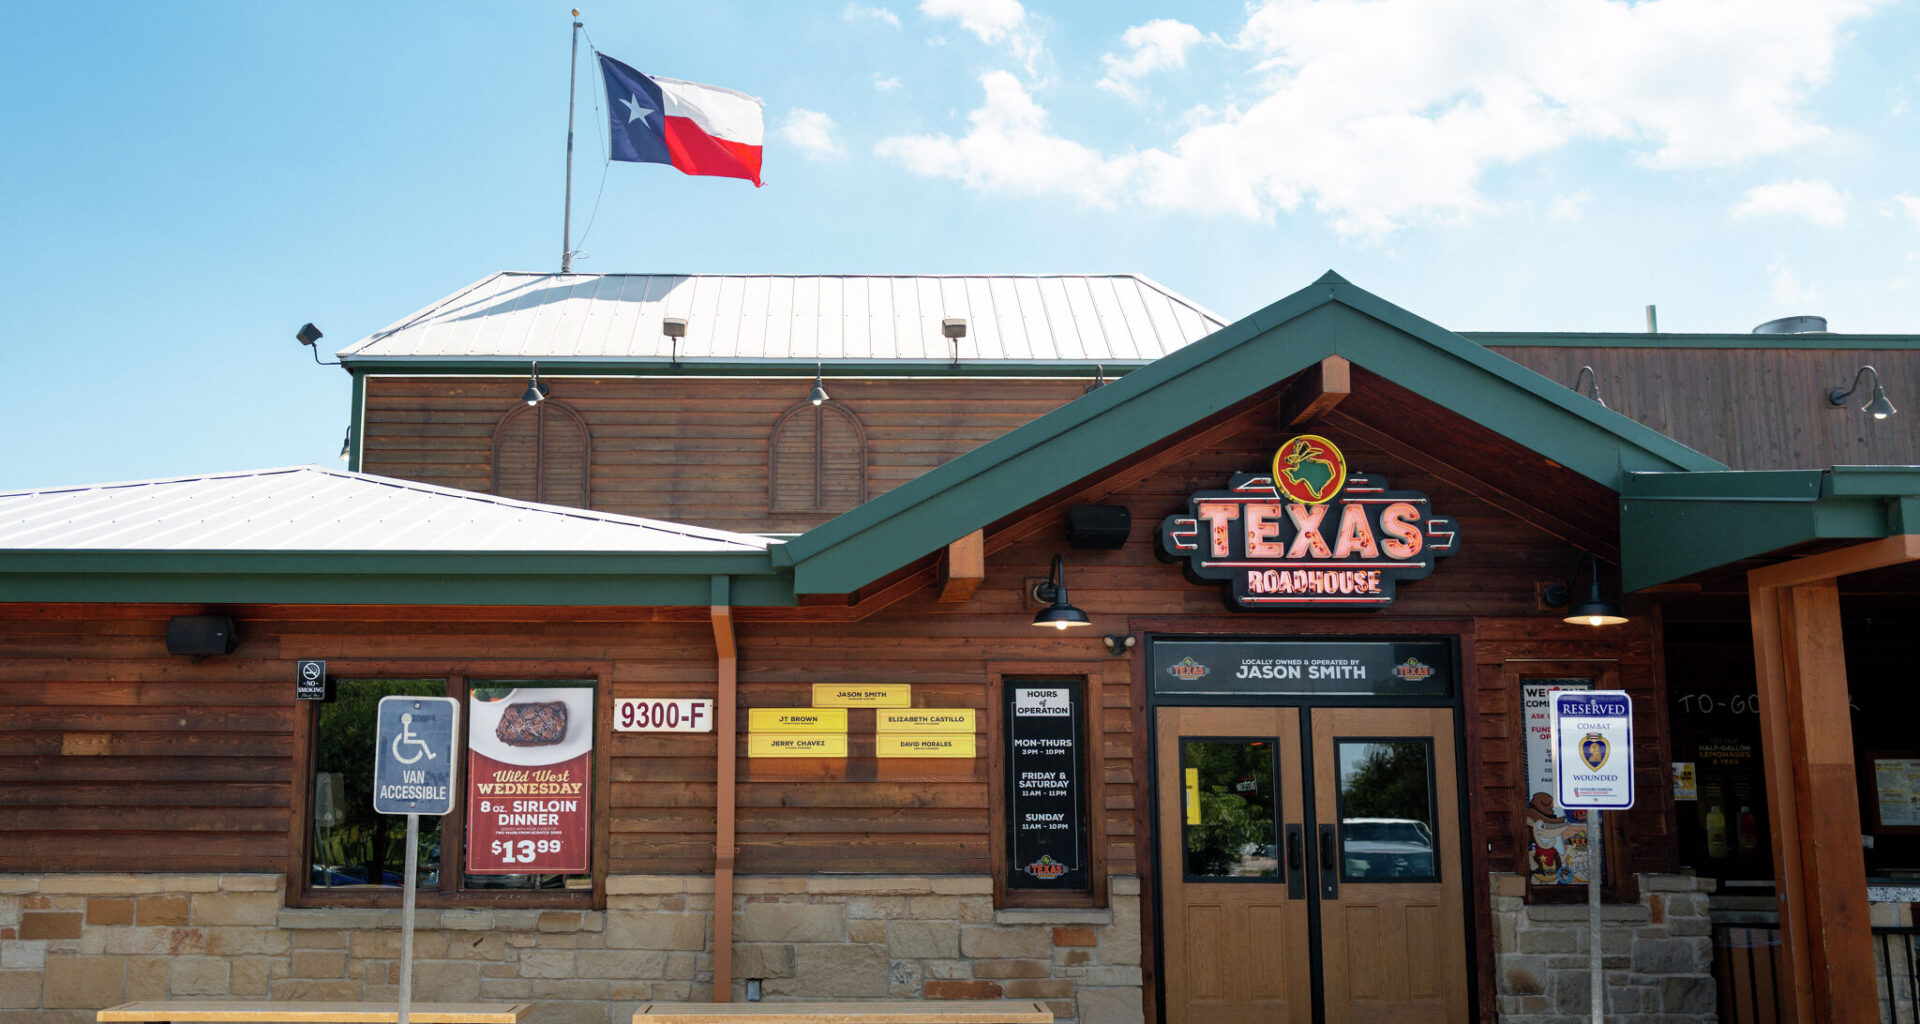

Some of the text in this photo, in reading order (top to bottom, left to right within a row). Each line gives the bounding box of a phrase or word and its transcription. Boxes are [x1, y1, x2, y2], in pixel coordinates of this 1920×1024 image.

[1198, 503, 1423, 560] TEXAS
[1248, 569, 1382, 594] ROADHOUSE
[1173, 666, 1204, 675] TEXAS
[1236, 666, 1366, 678] JASON SMITH
[1398, 667, 1429, 676] TEXAS
[1526, 688, 1546, 698] WE
[621, 702, 705, 728] 9300-F
[1563, 704, 1625, 714] RESERVED
[1014, 739, 1072, 747] MON-THURS
[403, 770, 424, 784] VAN
[492, 770, 570, 782] Wild West
[1022, 772, 1066, 780] FRIDAY &
[380, 785, 446, 800] ACCESSIBLE
[478, 782, 582, 794] WEDNESDAY
[480, 800, 490, 812] 8
[498, 814, 559, 826] DINNER
[1026, 814, 1064, 822] SUNDAY
[1032, 864, 1062, 874] TEXAS
